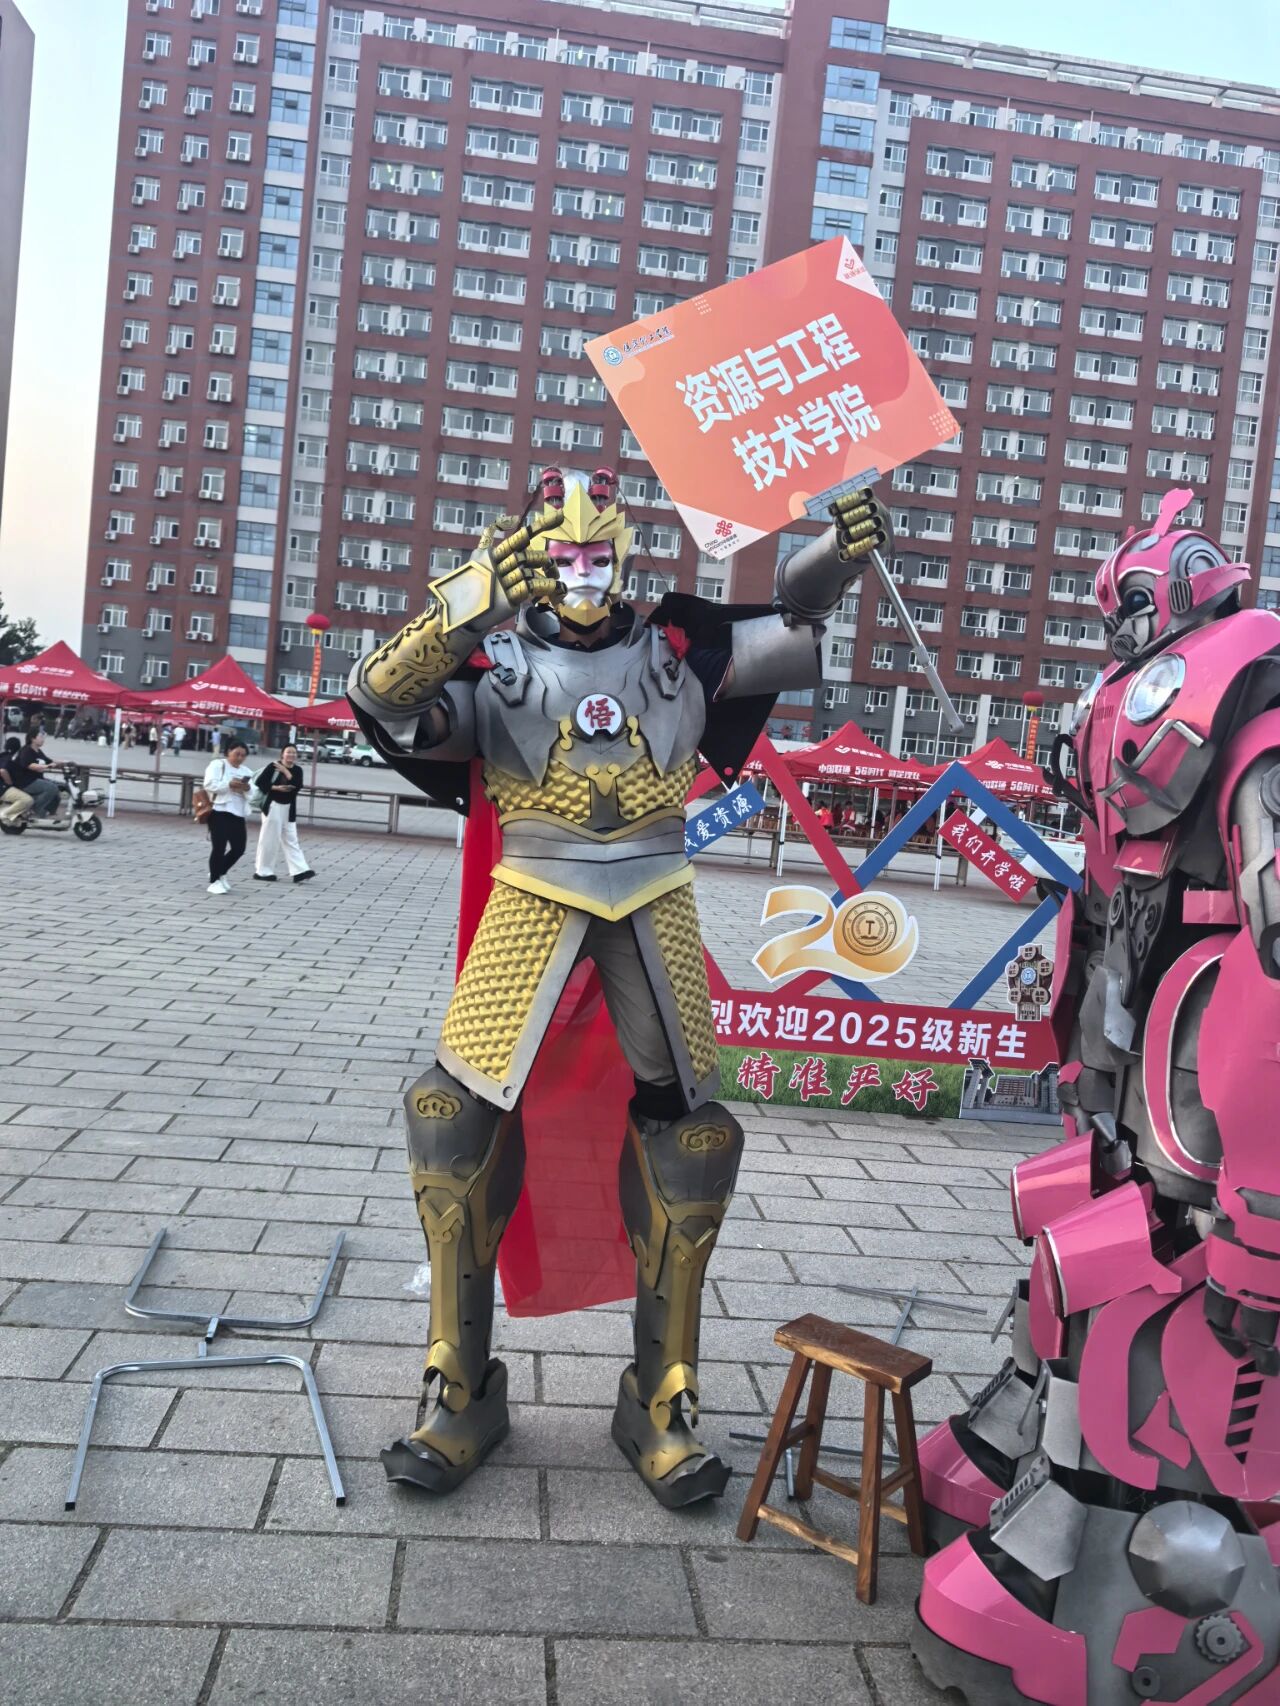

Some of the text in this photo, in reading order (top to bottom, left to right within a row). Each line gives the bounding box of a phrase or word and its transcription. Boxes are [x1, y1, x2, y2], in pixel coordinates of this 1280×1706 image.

[675, 312, 861, 433] 资源与工程
[731, 383, 881, 491] 技术学院
[584, 697, 616, 729] 悟
[818, 763, 851, 776] 中国联通
[854, 765, 884, 778] 5G时代
[951, 822, 1027, 892] 我们开学啦
[737, 1051, 940, 1112] 精准严好
